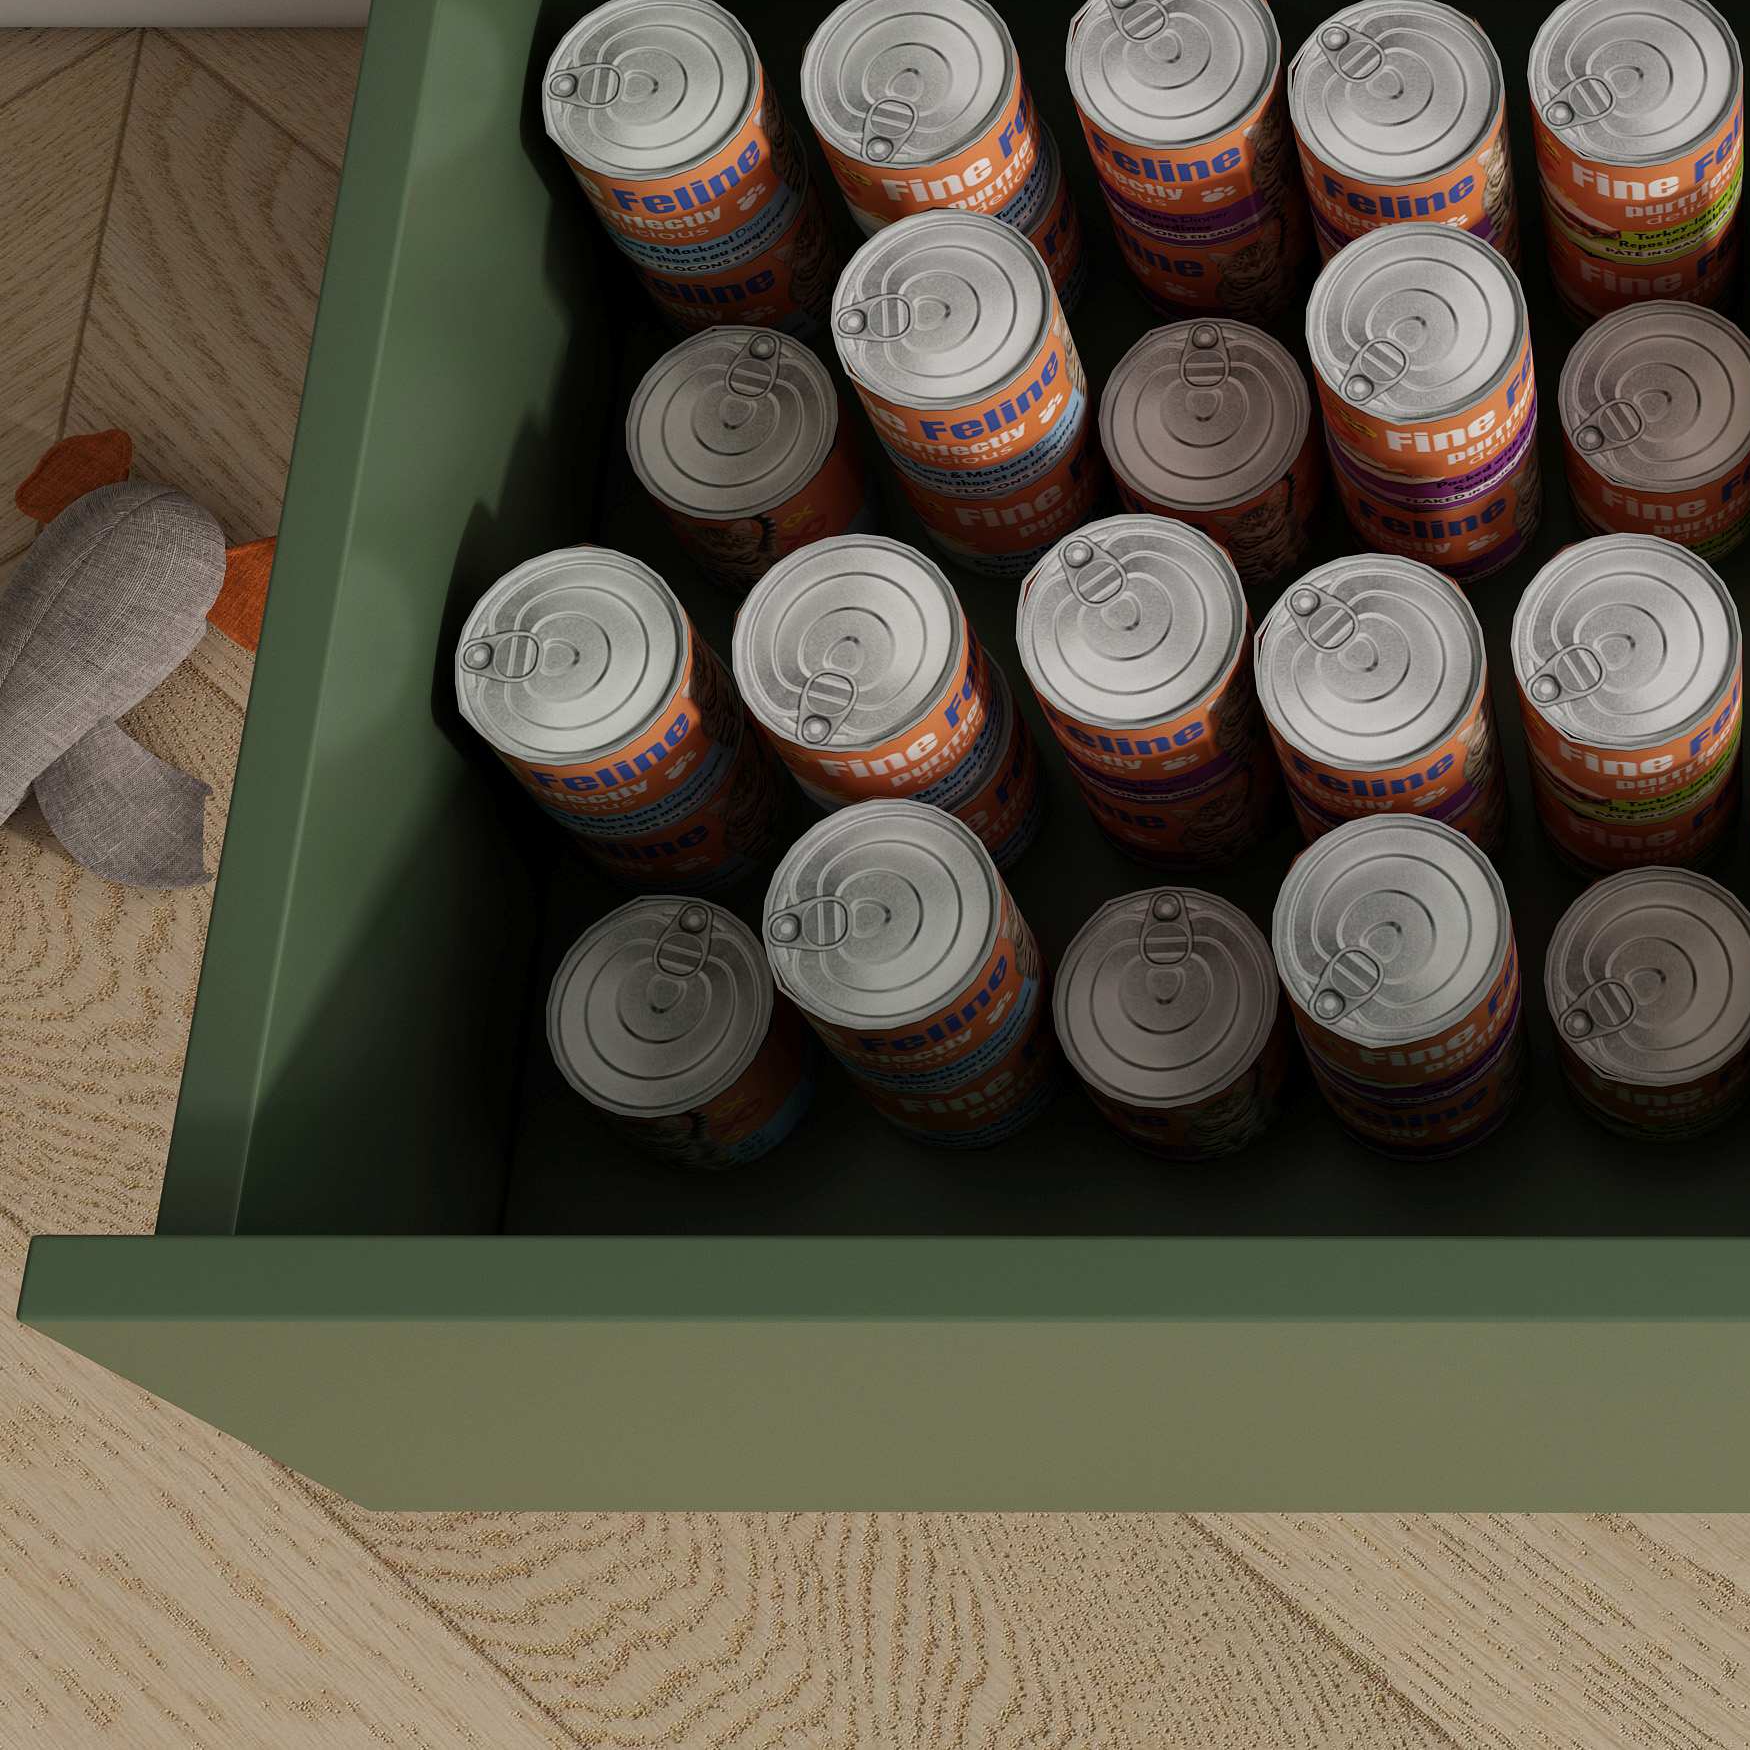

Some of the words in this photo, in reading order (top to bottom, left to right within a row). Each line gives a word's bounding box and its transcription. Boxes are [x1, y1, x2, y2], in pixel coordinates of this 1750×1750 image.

[1091, 128, 1242, 182] Feline
[612, 140, 761, 214] Feline
[881, 157, 992, 202] Fine
[1322, 171, 1474, 218] Feline
[1572, 162, 1680, 200] Fine
[665, 235, 733, 256] Mackerel
[652, 270, 775, 303] eline
[1581, 259, 1682, 296] Fine
[920, 351, 1058, 441] Feline
[1385, 410, 1496, 454] Fine
[955, 485, 1063, 528] Fine
[1603, 489, 1707, 520] Fine
[529, 713, 690, 791] Feline
[817, 732, 938, 778] Fine
[1560, 740, 1674, 777] Fine
[1359, 1024, 1477, 1066] Fine
